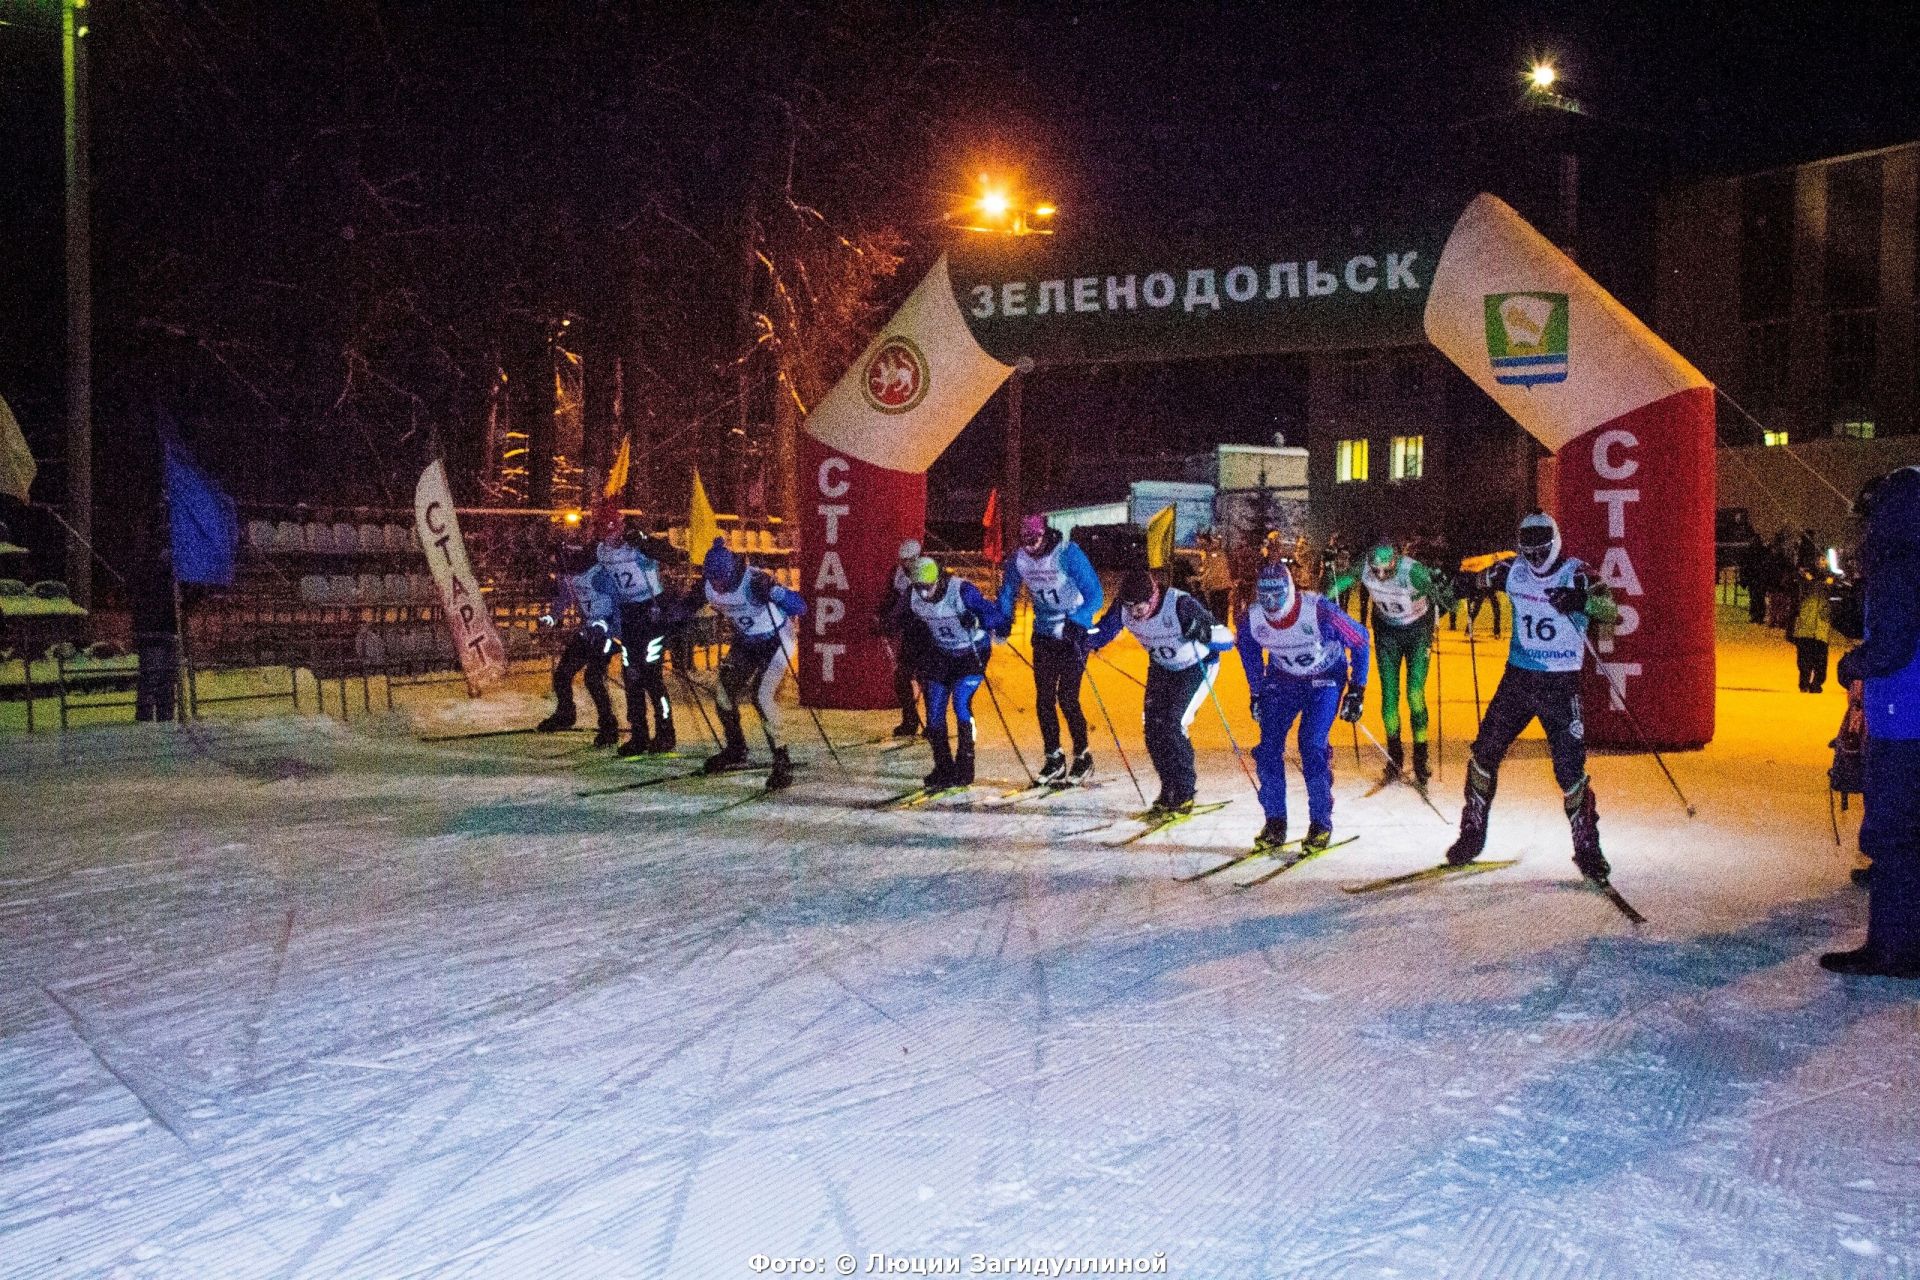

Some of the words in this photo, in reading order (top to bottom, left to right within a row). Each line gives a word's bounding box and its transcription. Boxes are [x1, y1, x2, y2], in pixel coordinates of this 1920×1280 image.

[970, 251, 1420, 318] ЗЕЛЕНОДОЛЬСК
[425, 501, 485, 668] СТАРТ
[613, 571, 637, 590] 12
[815, 456, 850, 682] СТАРТ
[1521, 614, 1557, 641] 16
[1591, 429, 1643, 711] СТАРТ
